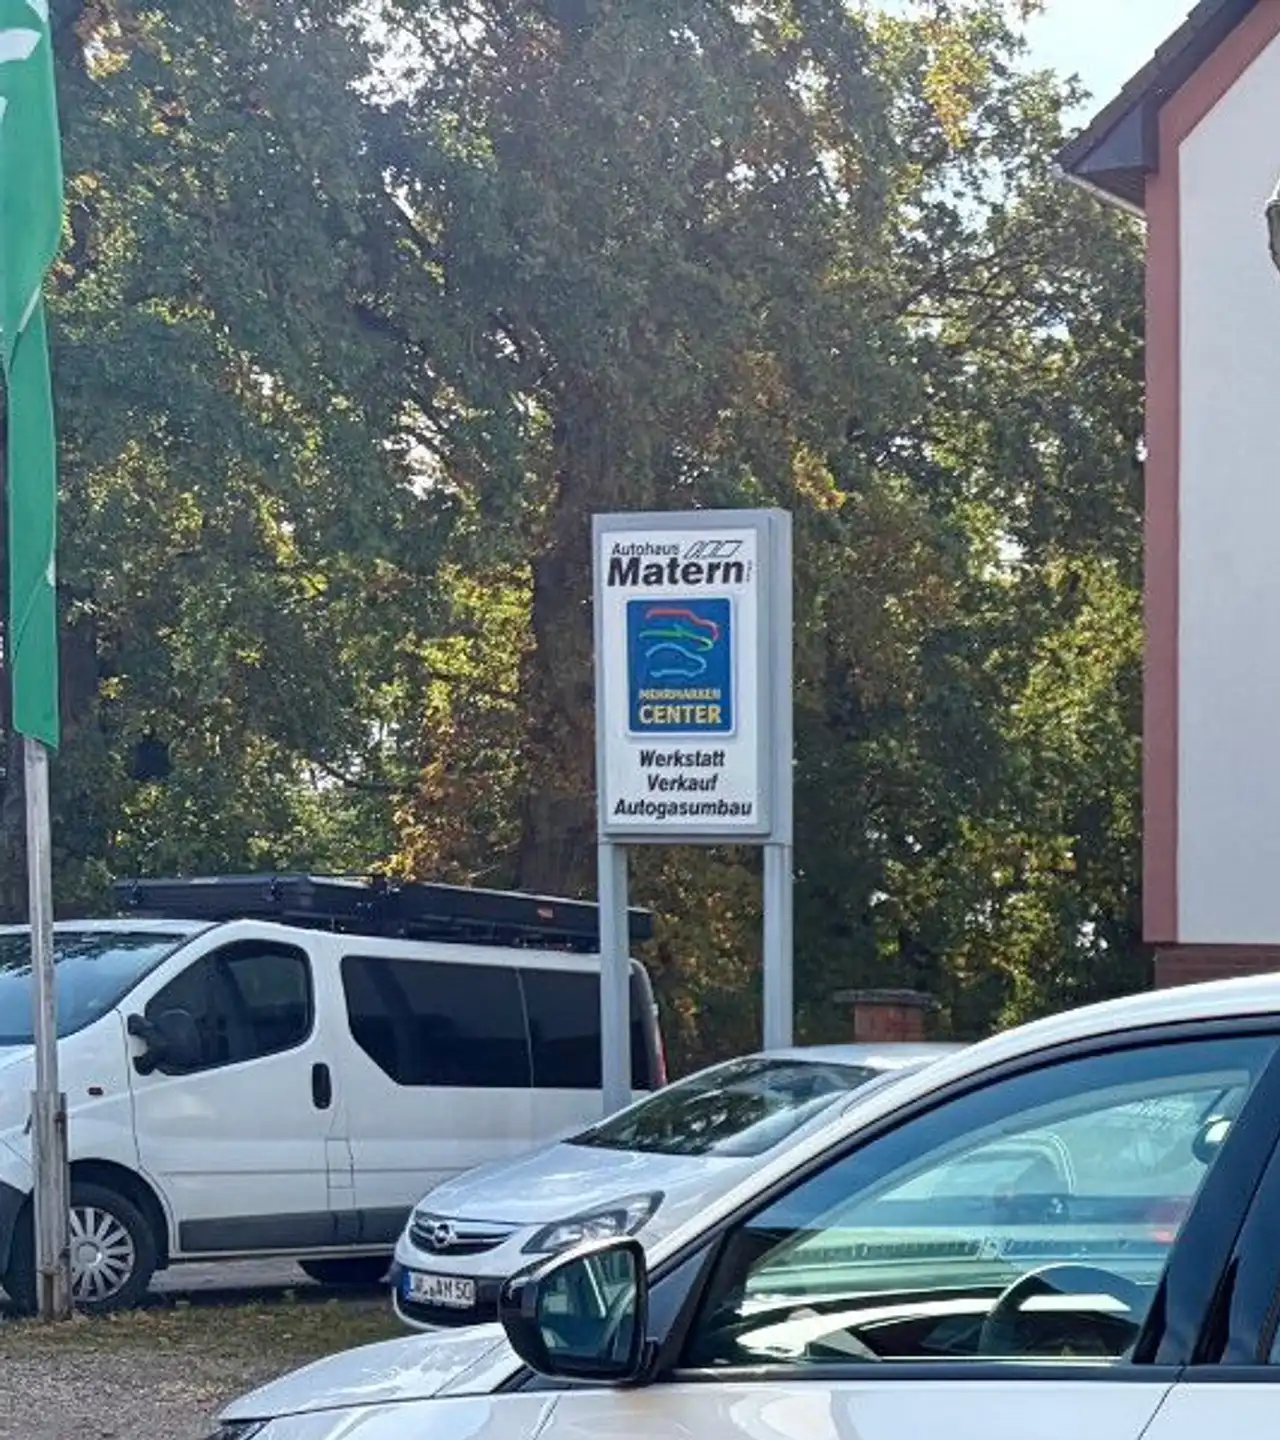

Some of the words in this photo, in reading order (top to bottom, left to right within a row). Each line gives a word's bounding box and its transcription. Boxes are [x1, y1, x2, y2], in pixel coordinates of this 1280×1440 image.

[612, 541, 680, 556] Autohaus
[606, 557, 745, 587] Matern
[639, 704, 722, 724] CENTER
[640, 749, 725, 767] Werkstatt
[647, 773, 718, 791] Verkauf
[614, 798, 752, 819] Autogasumbau
